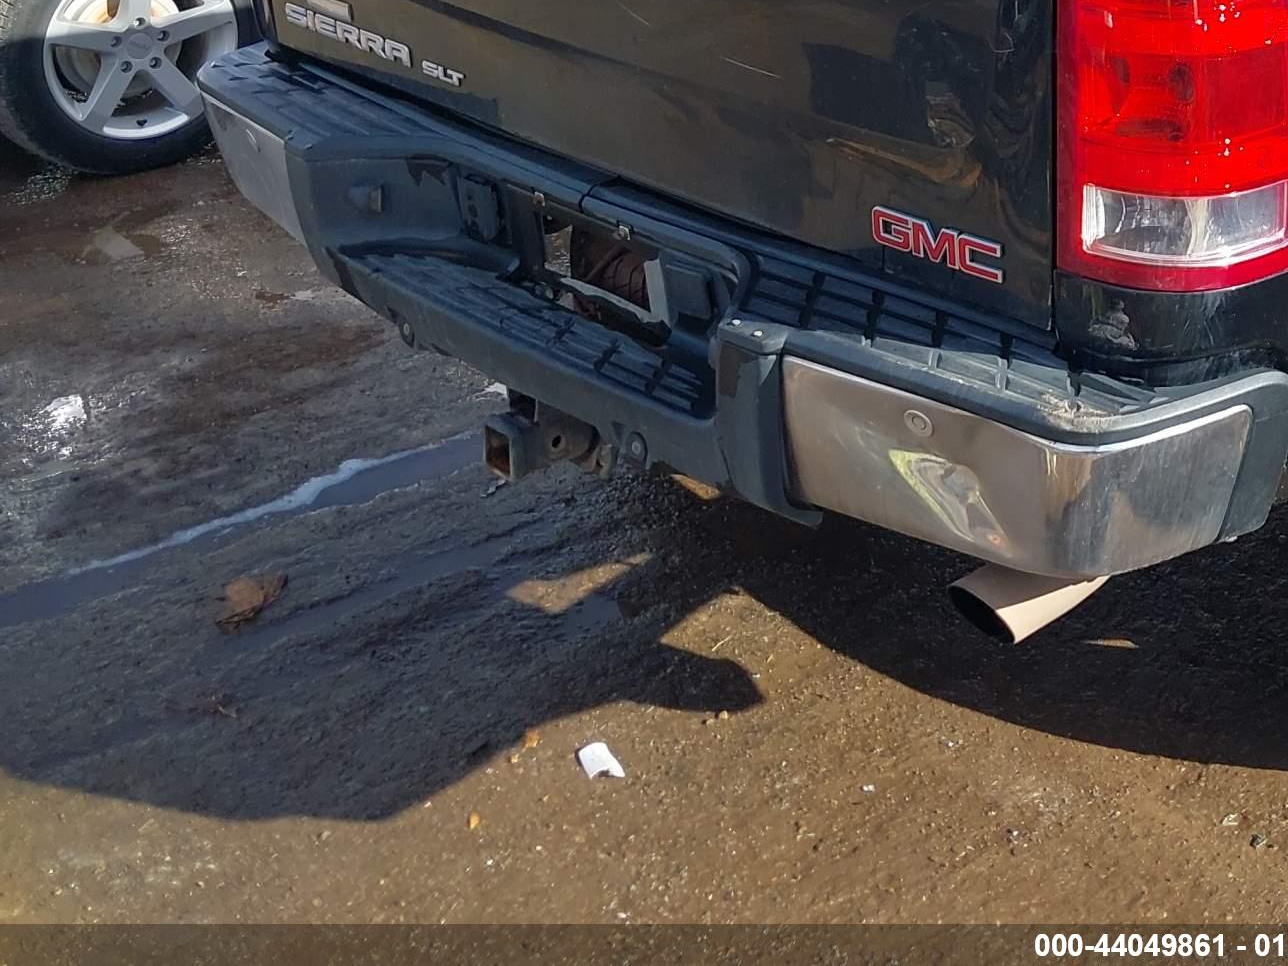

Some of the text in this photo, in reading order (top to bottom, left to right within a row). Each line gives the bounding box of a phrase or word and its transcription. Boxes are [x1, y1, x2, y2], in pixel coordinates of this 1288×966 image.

[285, 2, 466, 87] SIERRA SLT
[871, 205, 1004, 284] GMC
